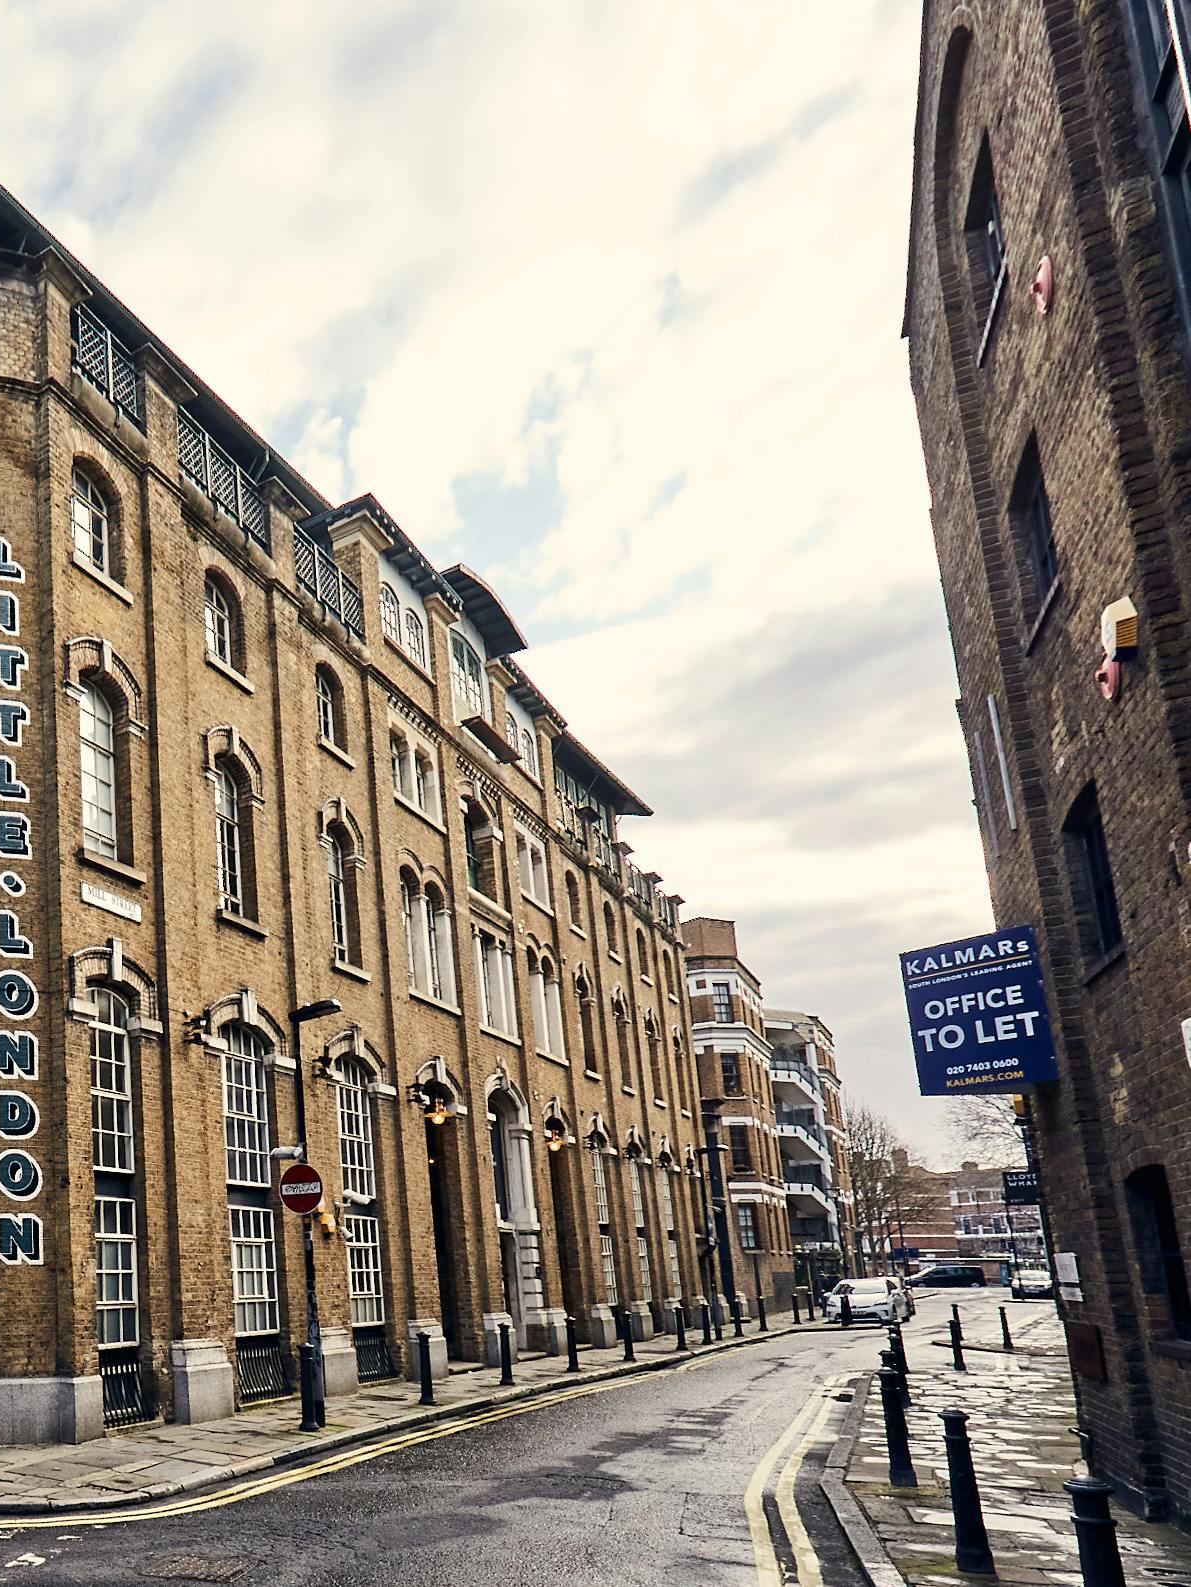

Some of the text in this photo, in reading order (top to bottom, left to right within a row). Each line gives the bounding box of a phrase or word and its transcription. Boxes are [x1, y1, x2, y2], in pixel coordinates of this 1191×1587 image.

[908, 959, 1033, 990] SOUTH LONDON'S LEADING AGENT
[924, 984, 1025, 1020] OFFICE
[917, 1011, 1040, 1053] TO LET
[946, 1057, 1019, 1075] 020 7403 0600
[946, 1070, 1024, 1088] KALMARS.COM
